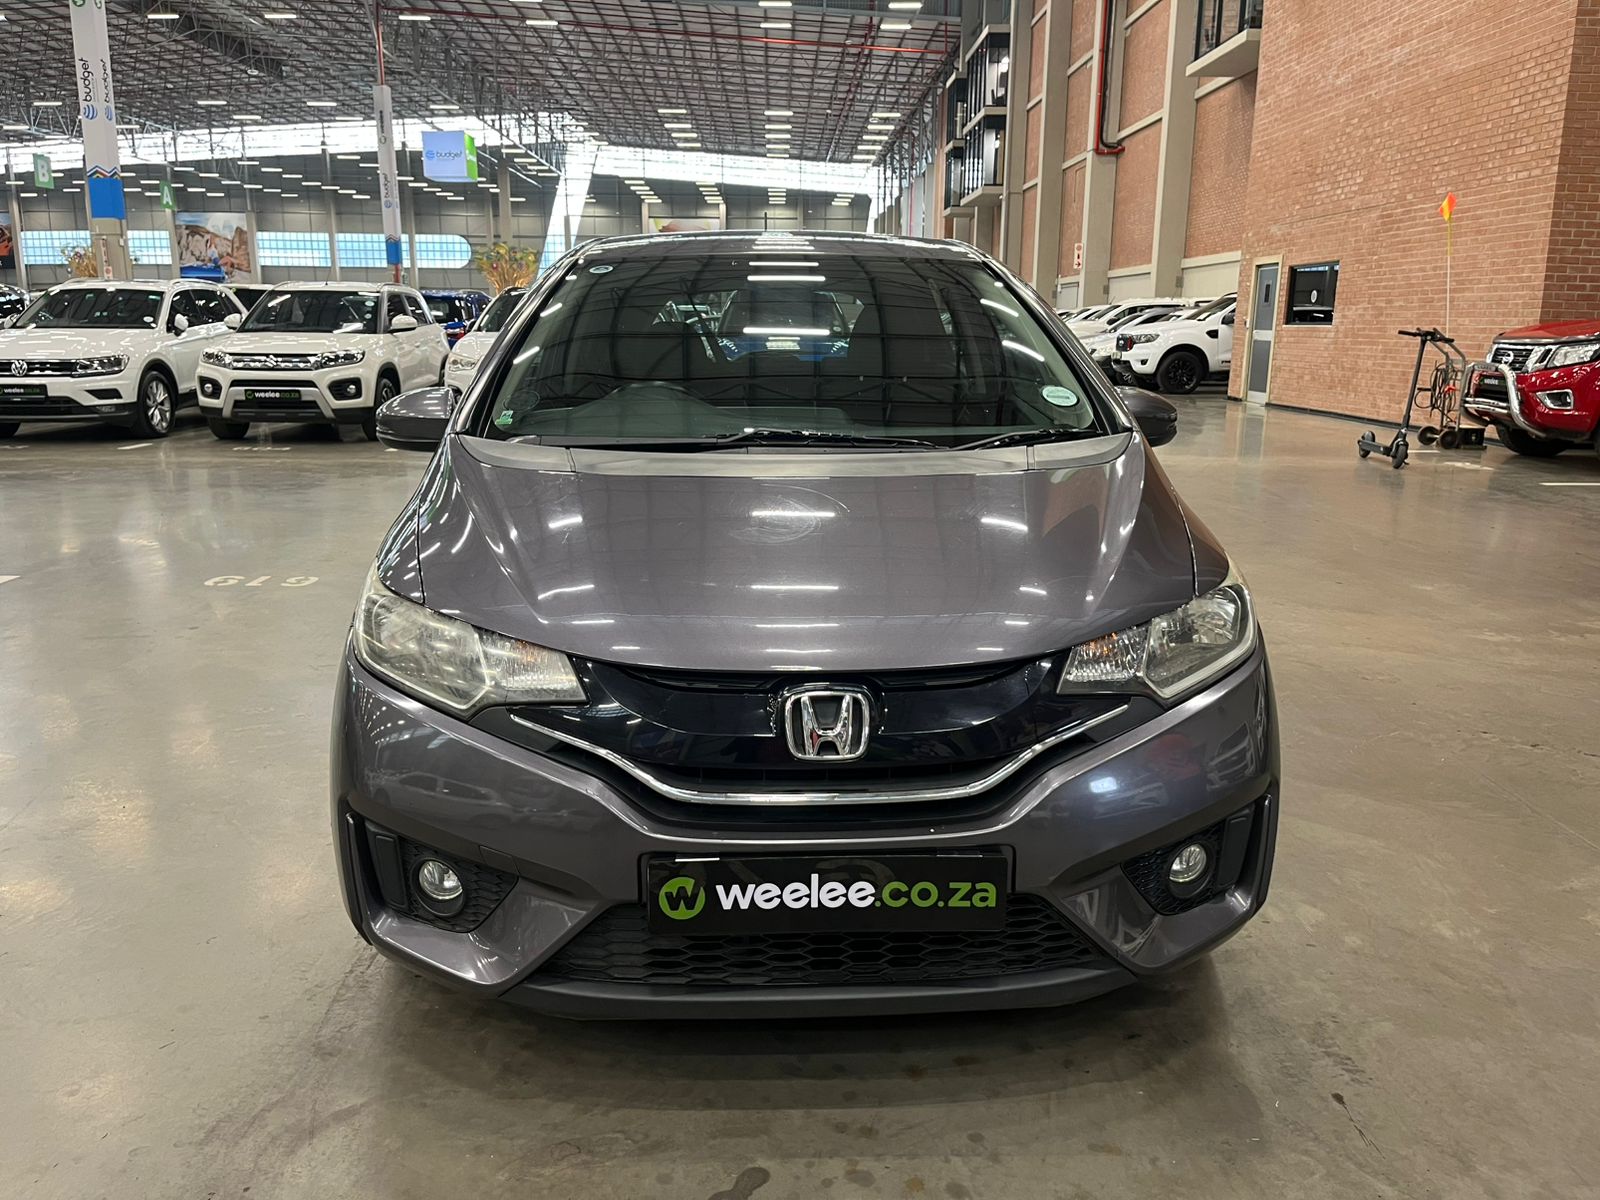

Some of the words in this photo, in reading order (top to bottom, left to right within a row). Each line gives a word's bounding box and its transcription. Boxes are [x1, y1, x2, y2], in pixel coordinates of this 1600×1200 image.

[78, 57, 93, 102] budget
[100, 59, 110, 103] budget
[436, 150, 462, 160] budget
[37, 157, 49, 182] B
[163, 186, 173, 206] A
[382, 173, 390, 198] budget
[203, 575, 320, 587] 619
[715, 873, 998, 911] weelee.co.za
